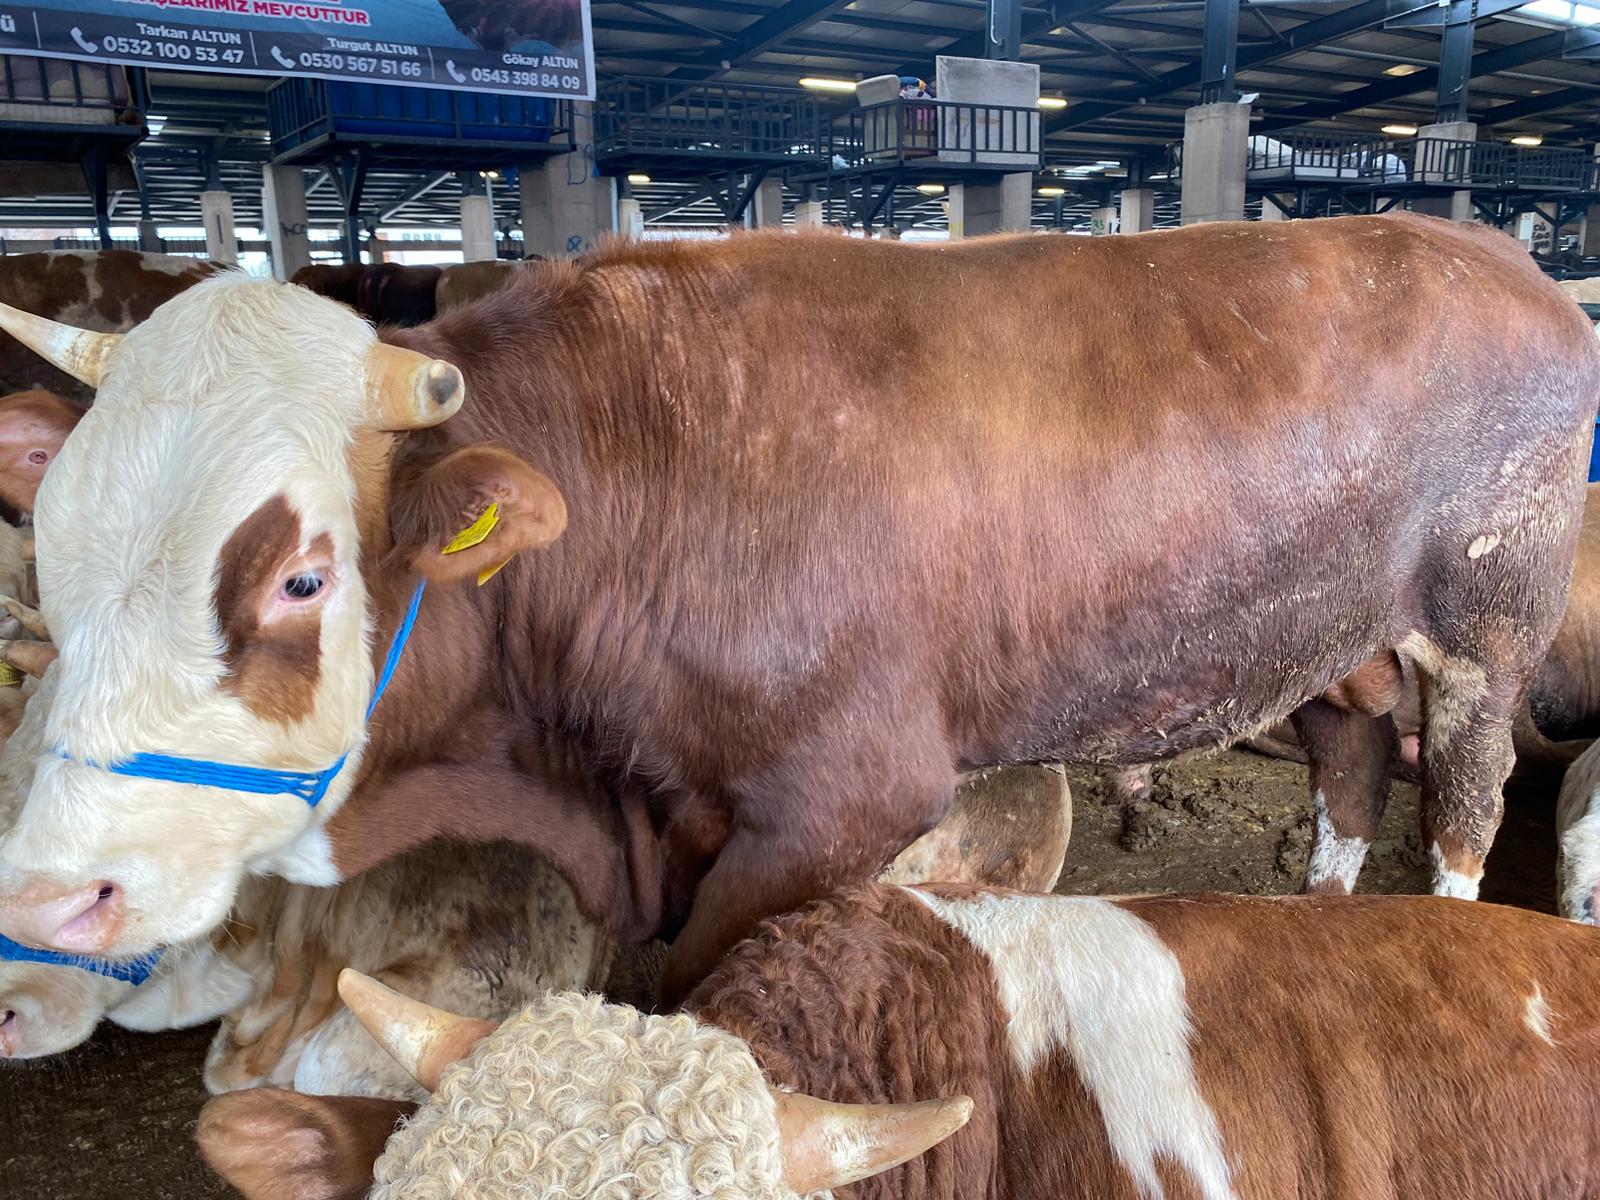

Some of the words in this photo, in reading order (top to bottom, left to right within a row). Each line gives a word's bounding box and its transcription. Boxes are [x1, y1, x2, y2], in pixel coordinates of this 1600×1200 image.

[253, 1, 369, 25] MEVCUTTUR
[136, 22, 188, 40] Tarkan
[191, 29, 242, 45] ALTUN
[103, 35, 153, 56] 0532
[156, 41, 192, 60] 100
[195, 46, 218, 62] 53
[222, 49, 244, 64] 47
[326, 37, 372, 52] Turgut
[375, 43, 419, 56] ALTUN
[300, 52, 344, 70] 0530
[347, 56, 378, 72] 567
[381, 60, 397, 75] 51
[400, 61, 422, 77] 66
[502, 53, 539, 68] Gökay
[542, 55, 579, 69] ALTUN
[471, 67, 510, 84] 0543
[512, 71, 539, 86] 398
[541, 74, 559, 88] 84
[561, 76, 581, 90] 09
